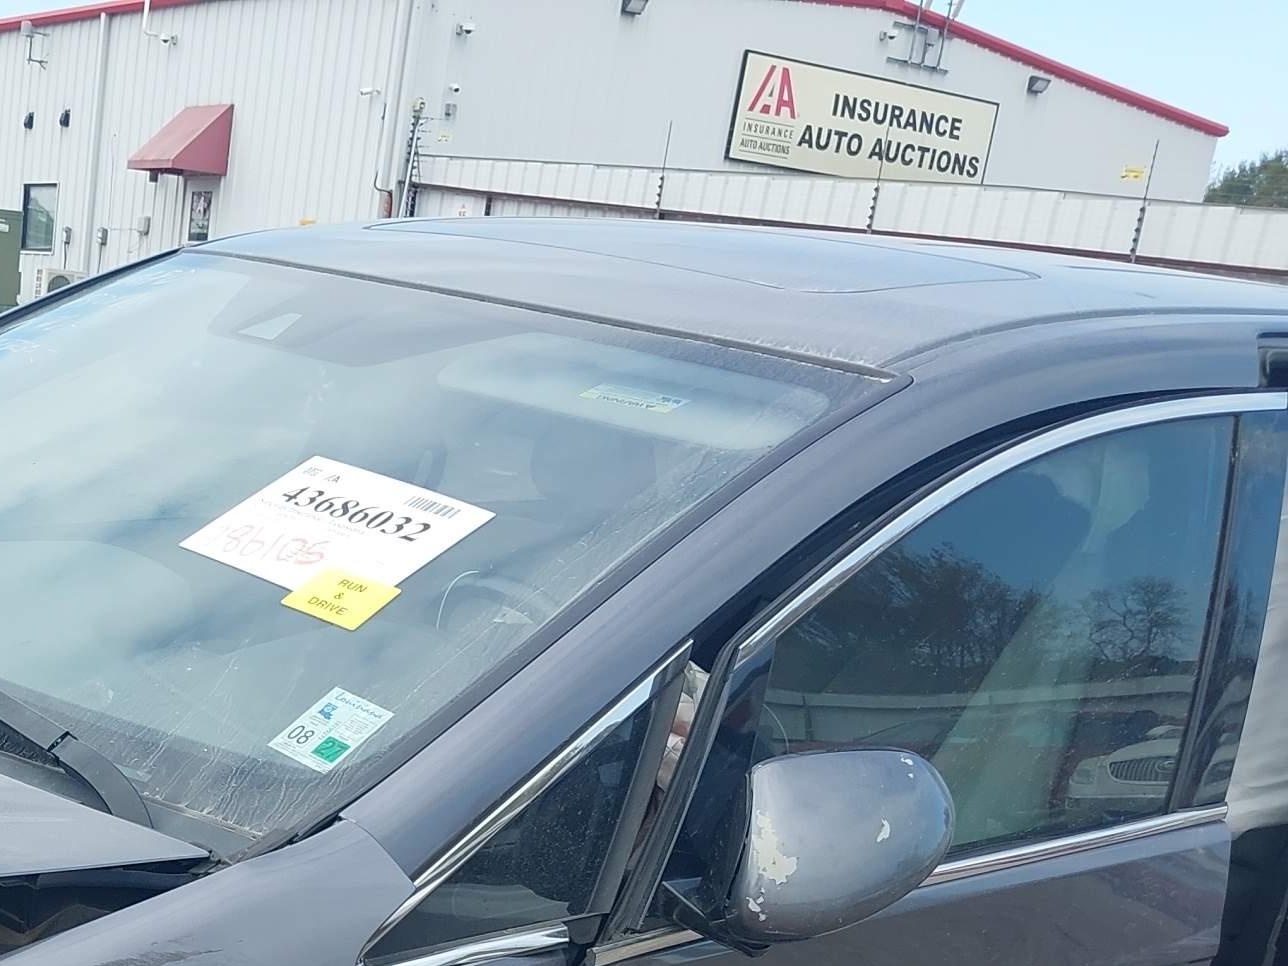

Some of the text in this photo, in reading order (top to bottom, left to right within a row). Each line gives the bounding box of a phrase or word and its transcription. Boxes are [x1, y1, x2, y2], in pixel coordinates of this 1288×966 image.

[831, 93, 962, 140] INSURANCE
[743, 122, 794, 139] INSURANCE
[740, 138, 791, 155] AUTO AUCTIONS
[797, 124, 980, 178] AUTO AUCTIONS
[281, 486, 431, 542] 43686032
[337, 578, 368, 592] RUN
[307, 596, 349, 616] DRIVE
[333, 592, 344, 600] &
[287, 725, 315, 745] 08
